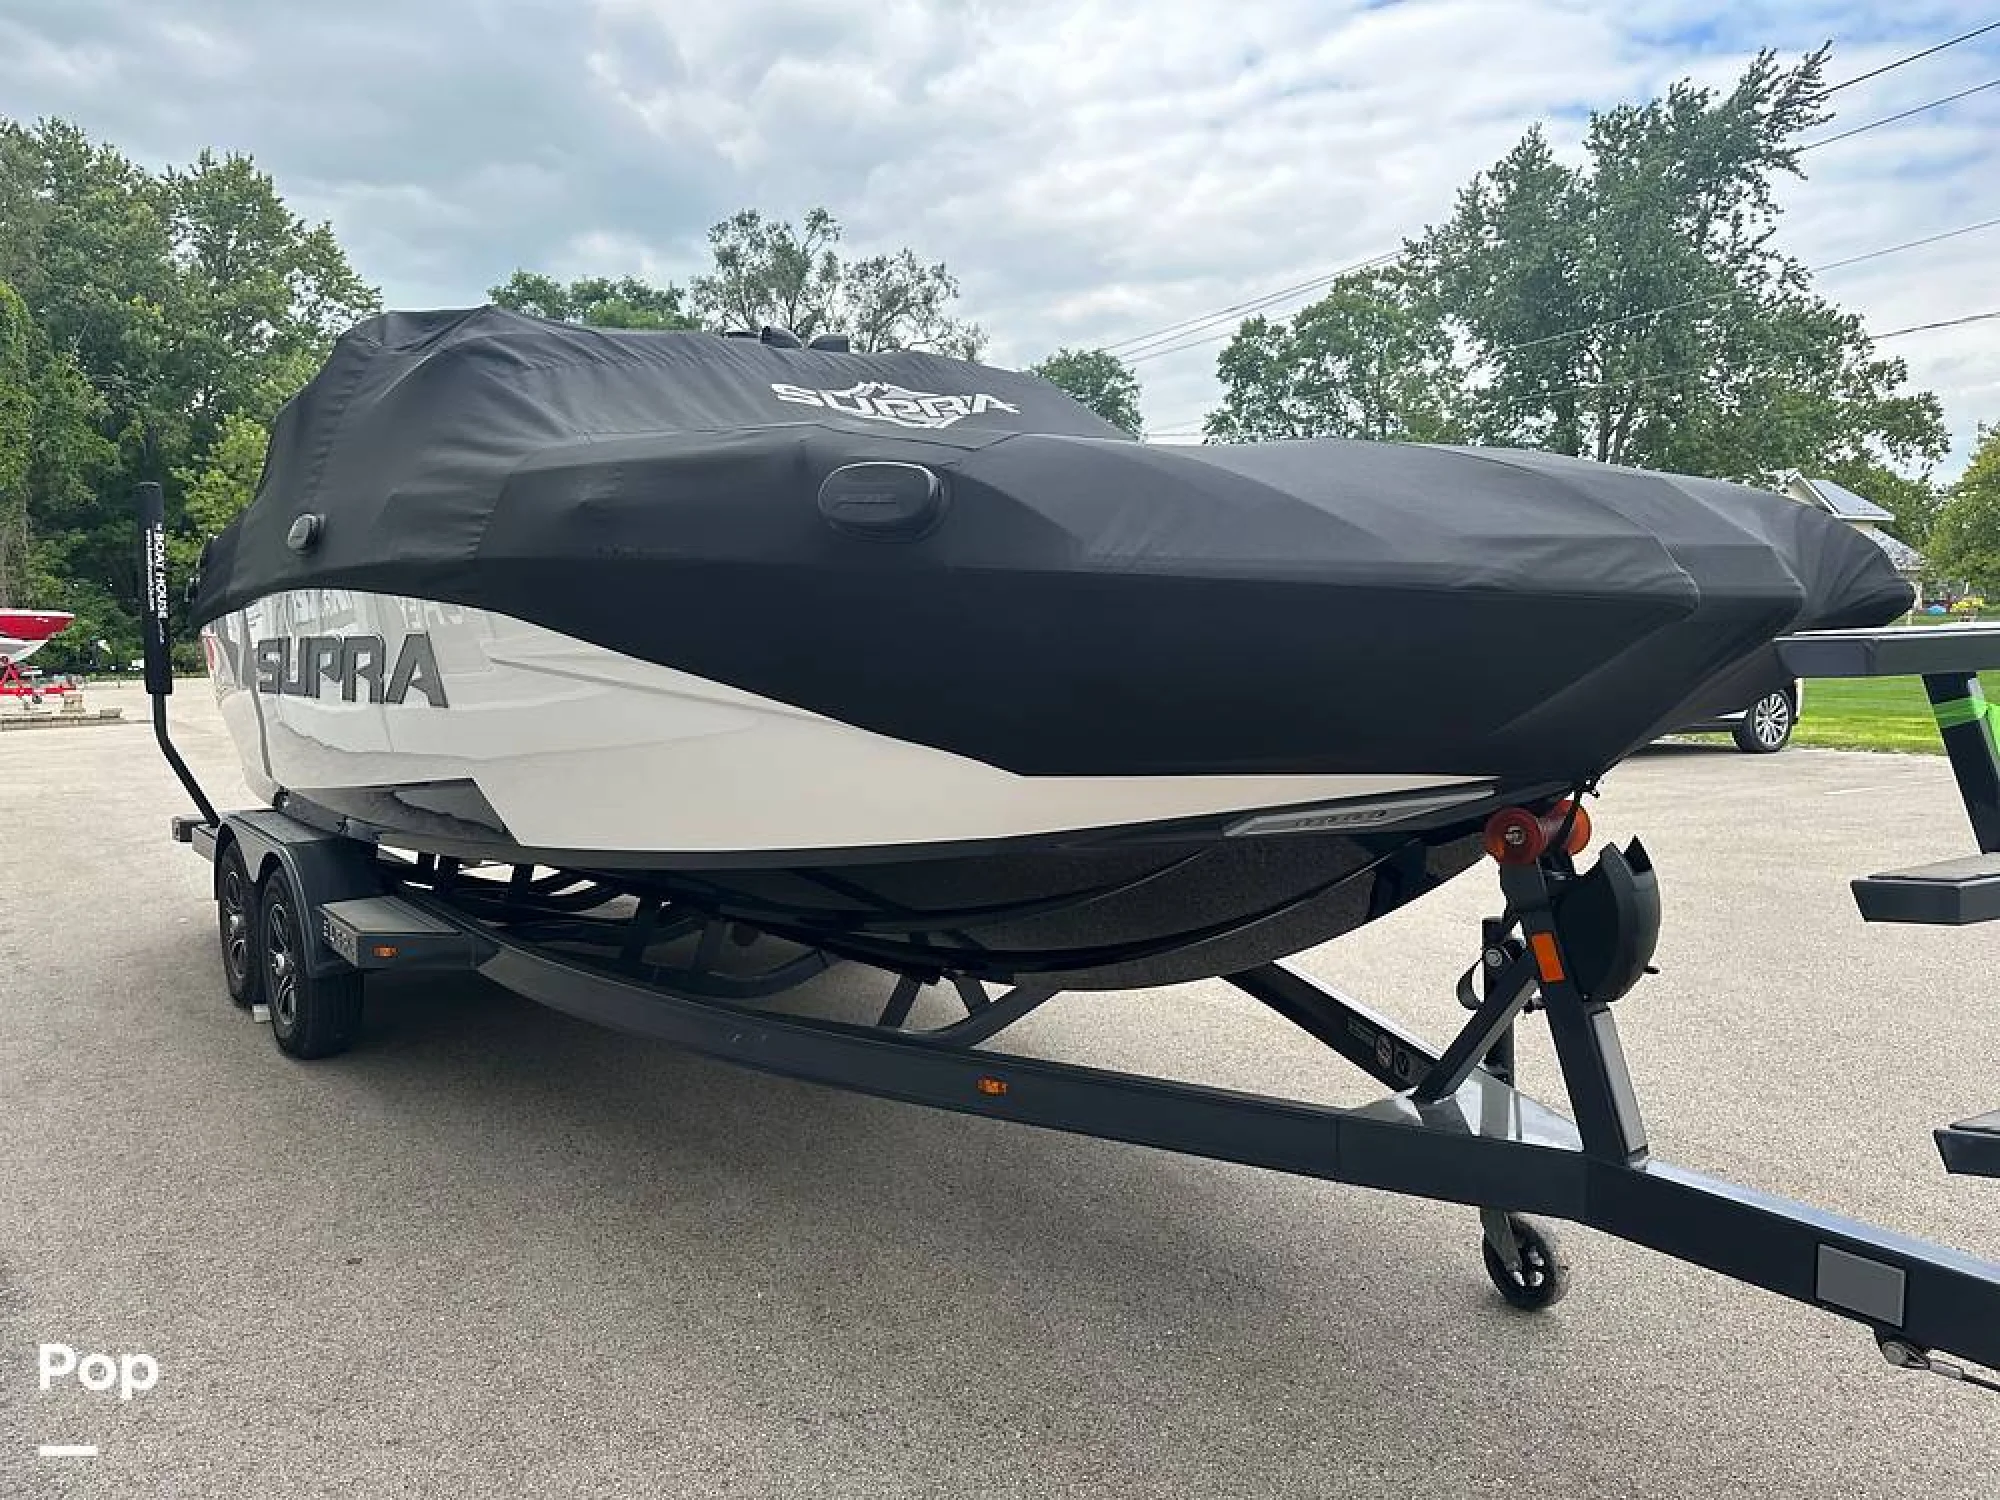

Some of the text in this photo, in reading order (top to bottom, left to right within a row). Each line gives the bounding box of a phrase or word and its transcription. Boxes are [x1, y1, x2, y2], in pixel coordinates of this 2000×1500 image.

[771, 383, 1021, 419] SUPRA
[154, 533, 165, 570] BOAT
[156, 571, 168, 618] HOUSE
[257, 633, 448, 708] SUPRA
